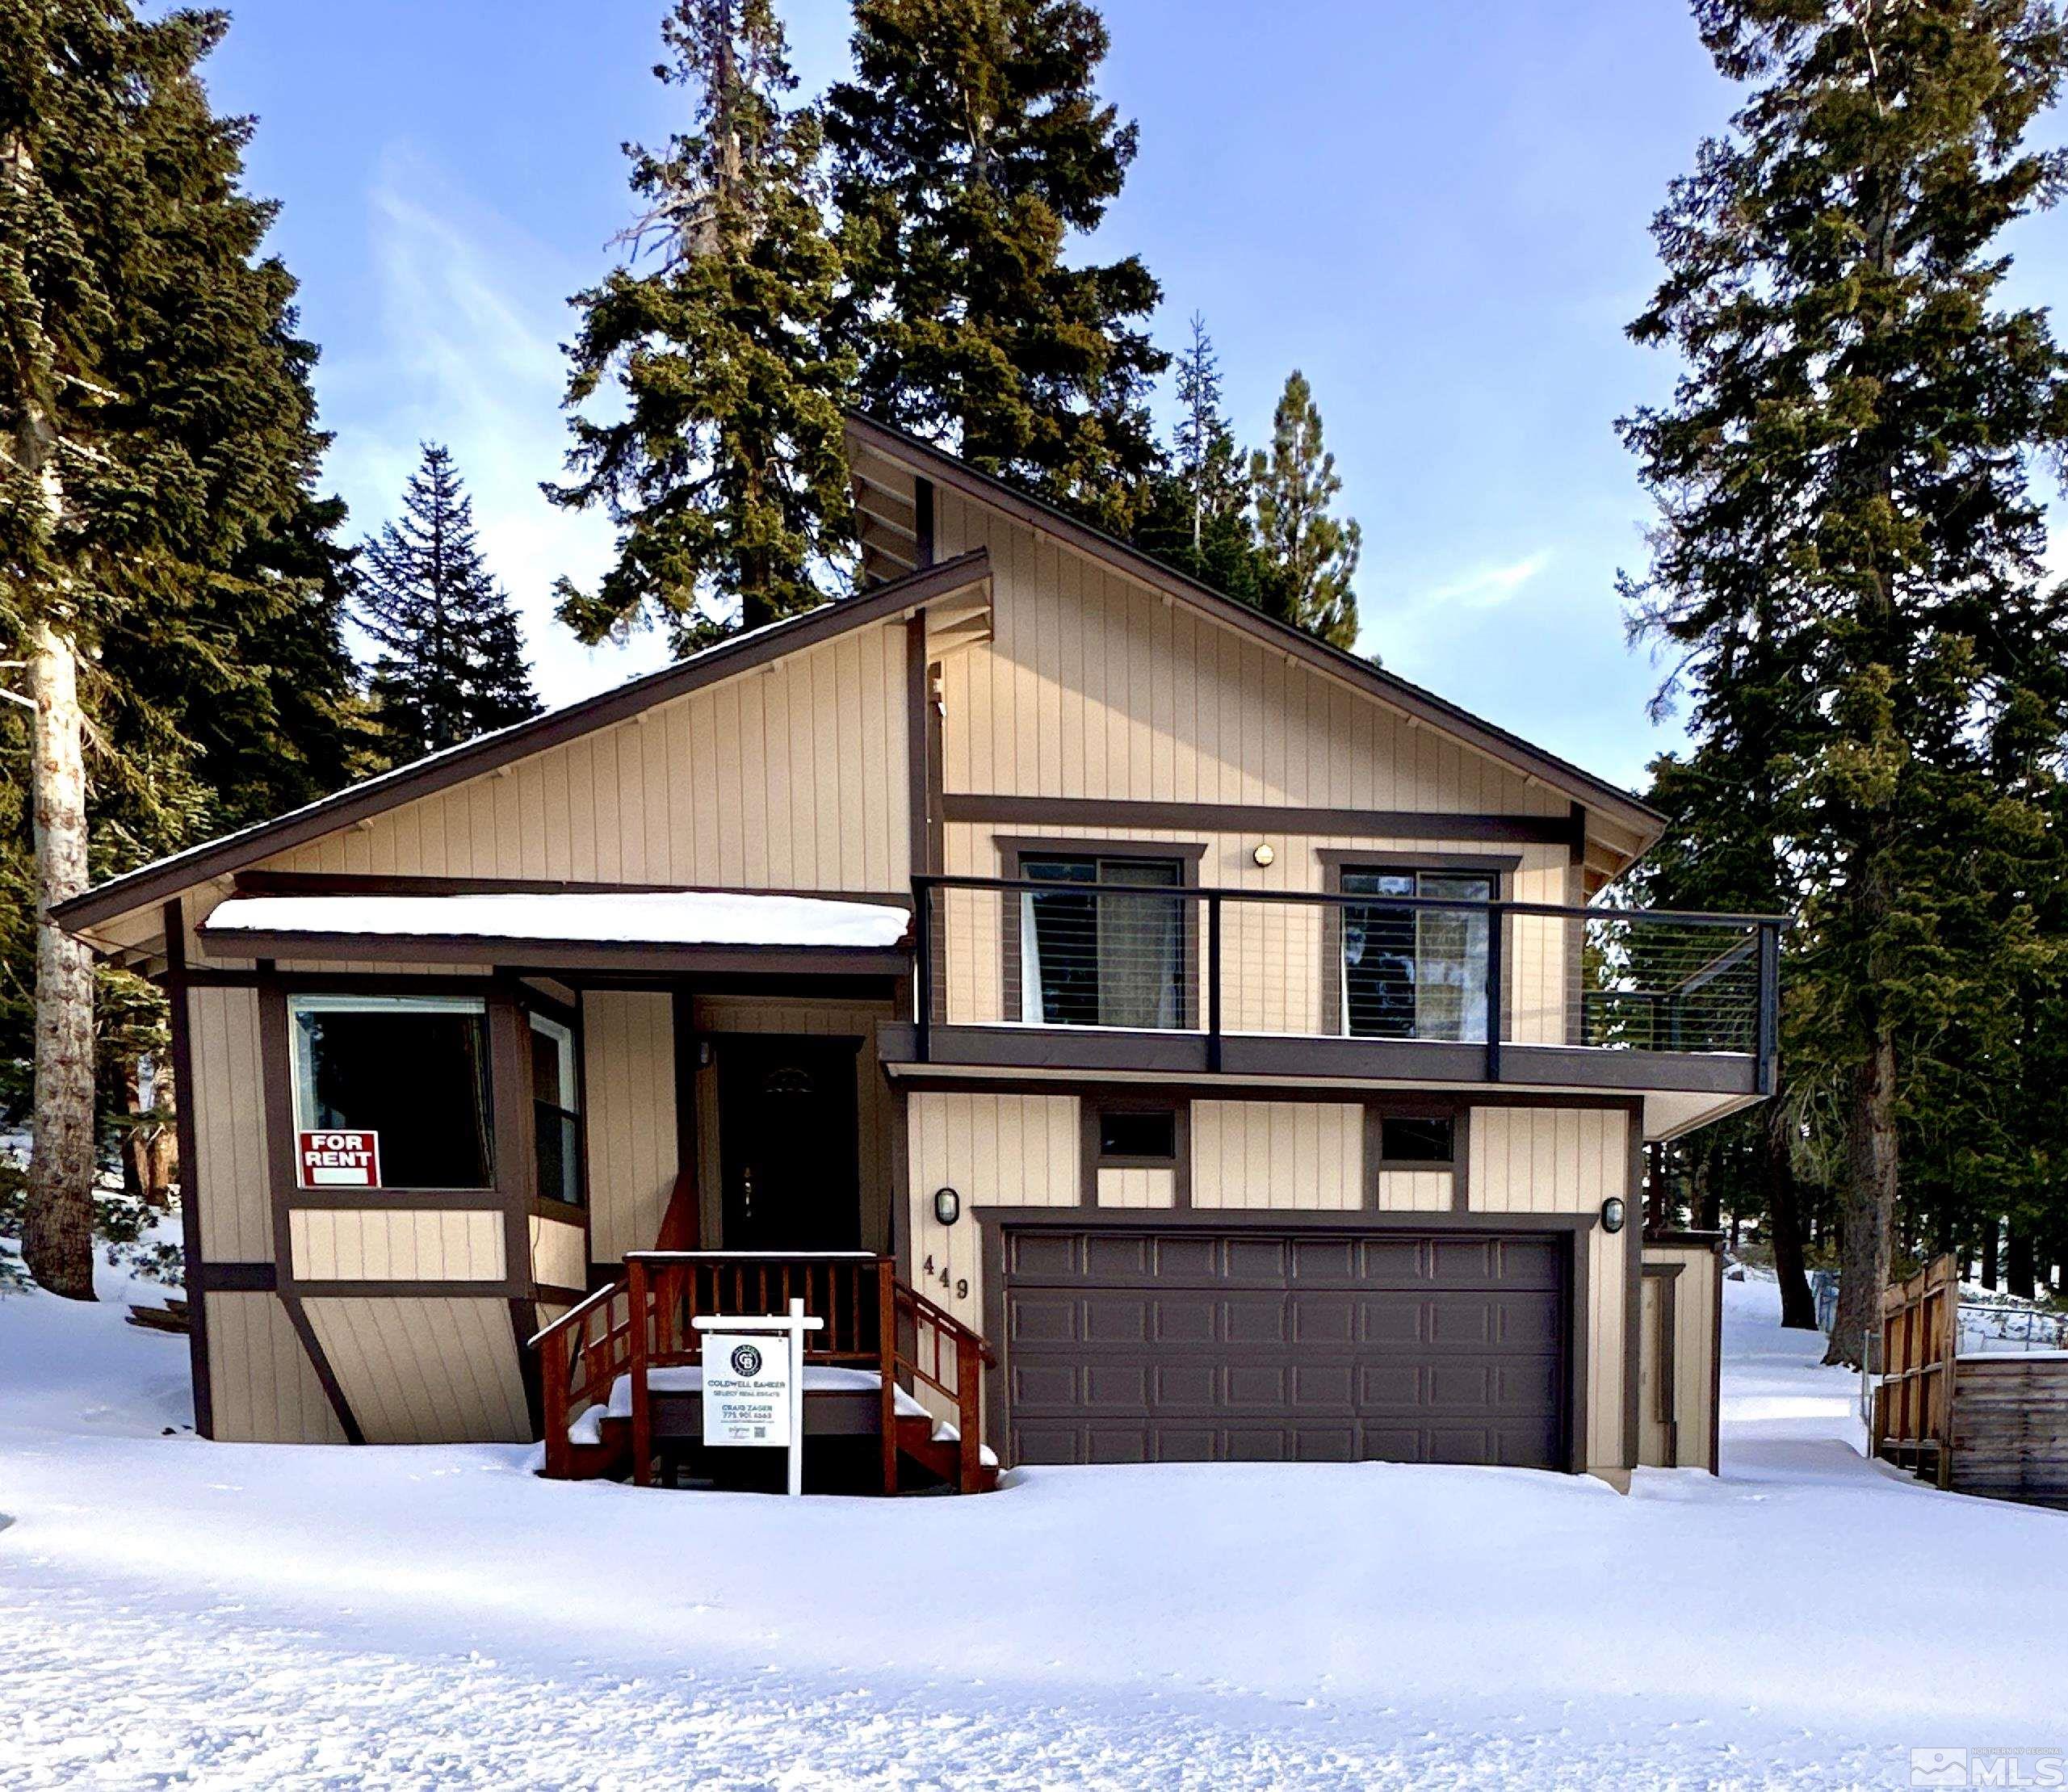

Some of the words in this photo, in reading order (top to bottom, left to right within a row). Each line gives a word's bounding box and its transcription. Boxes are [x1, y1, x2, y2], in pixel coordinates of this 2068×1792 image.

[311, 1135, 363, 1150] FOR
[304, 1151, 372, 1167] RENT
[923, 1254, 968, 1299] 449
